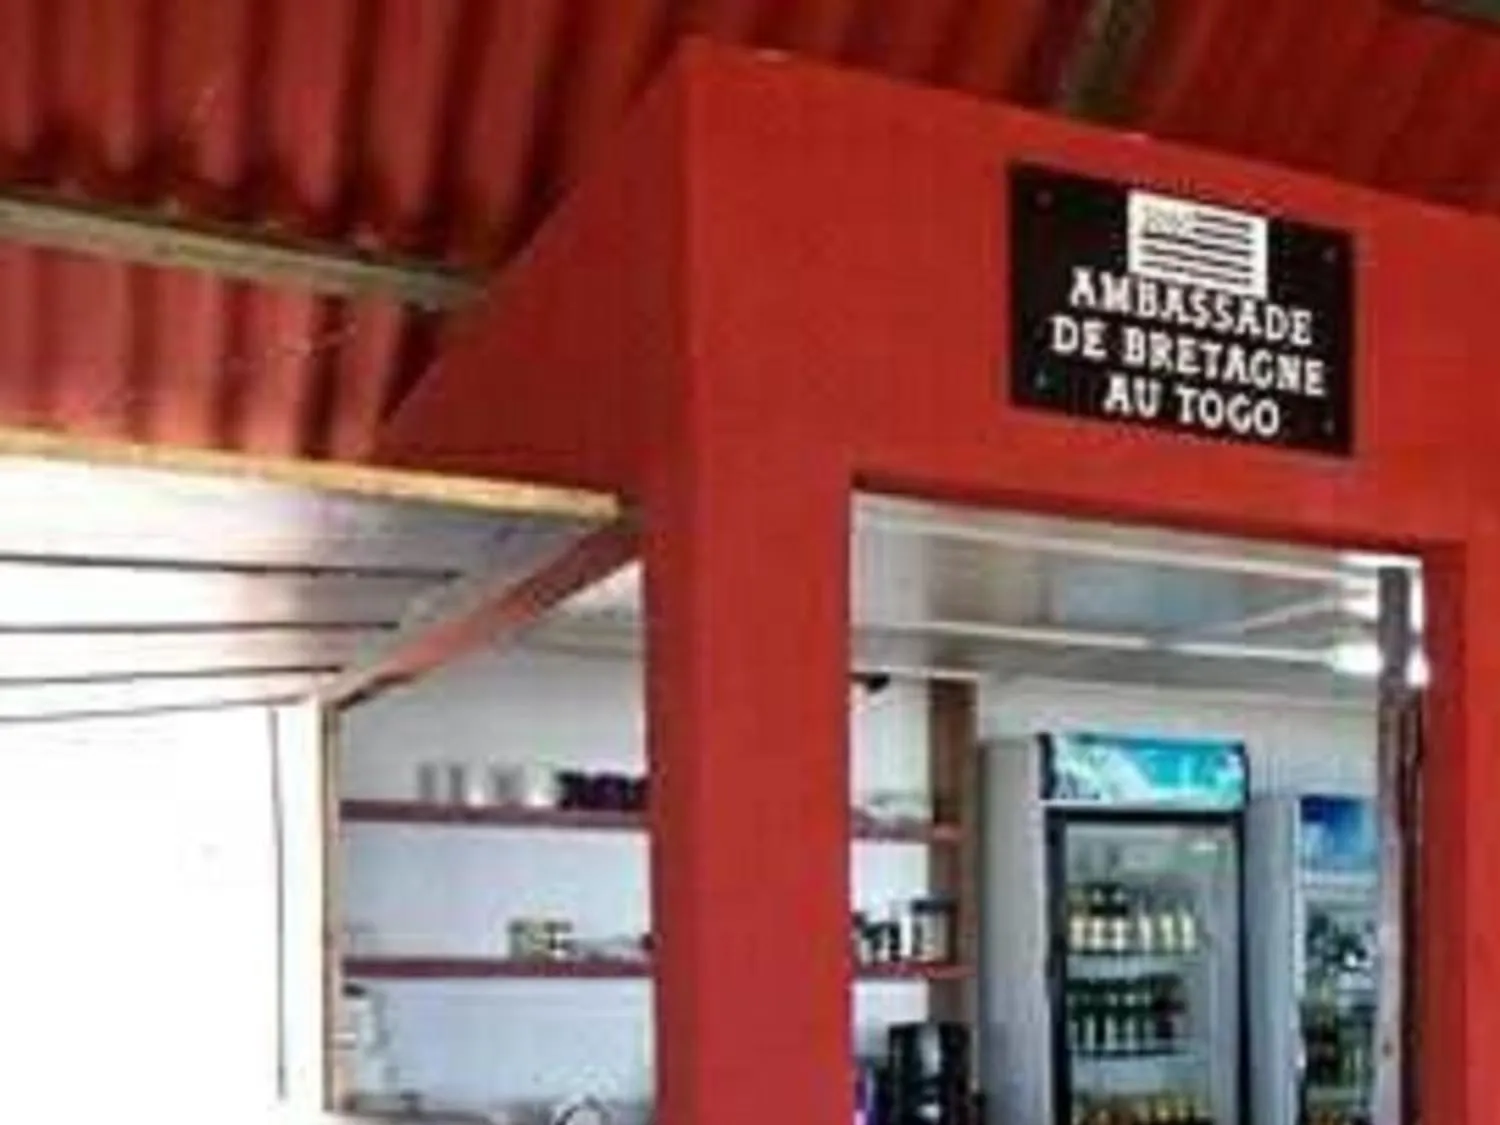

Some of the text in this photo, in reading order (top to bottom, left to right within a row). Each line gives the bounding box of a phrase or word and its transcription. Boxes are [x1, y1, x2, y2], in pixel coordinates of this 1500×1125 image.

[1069, 266, 1313, 346] AMBASSADE
[1052, 314, 1326, 397] DE BRETAGNE
[1103, 374, 1281, 436] AU TOGO
